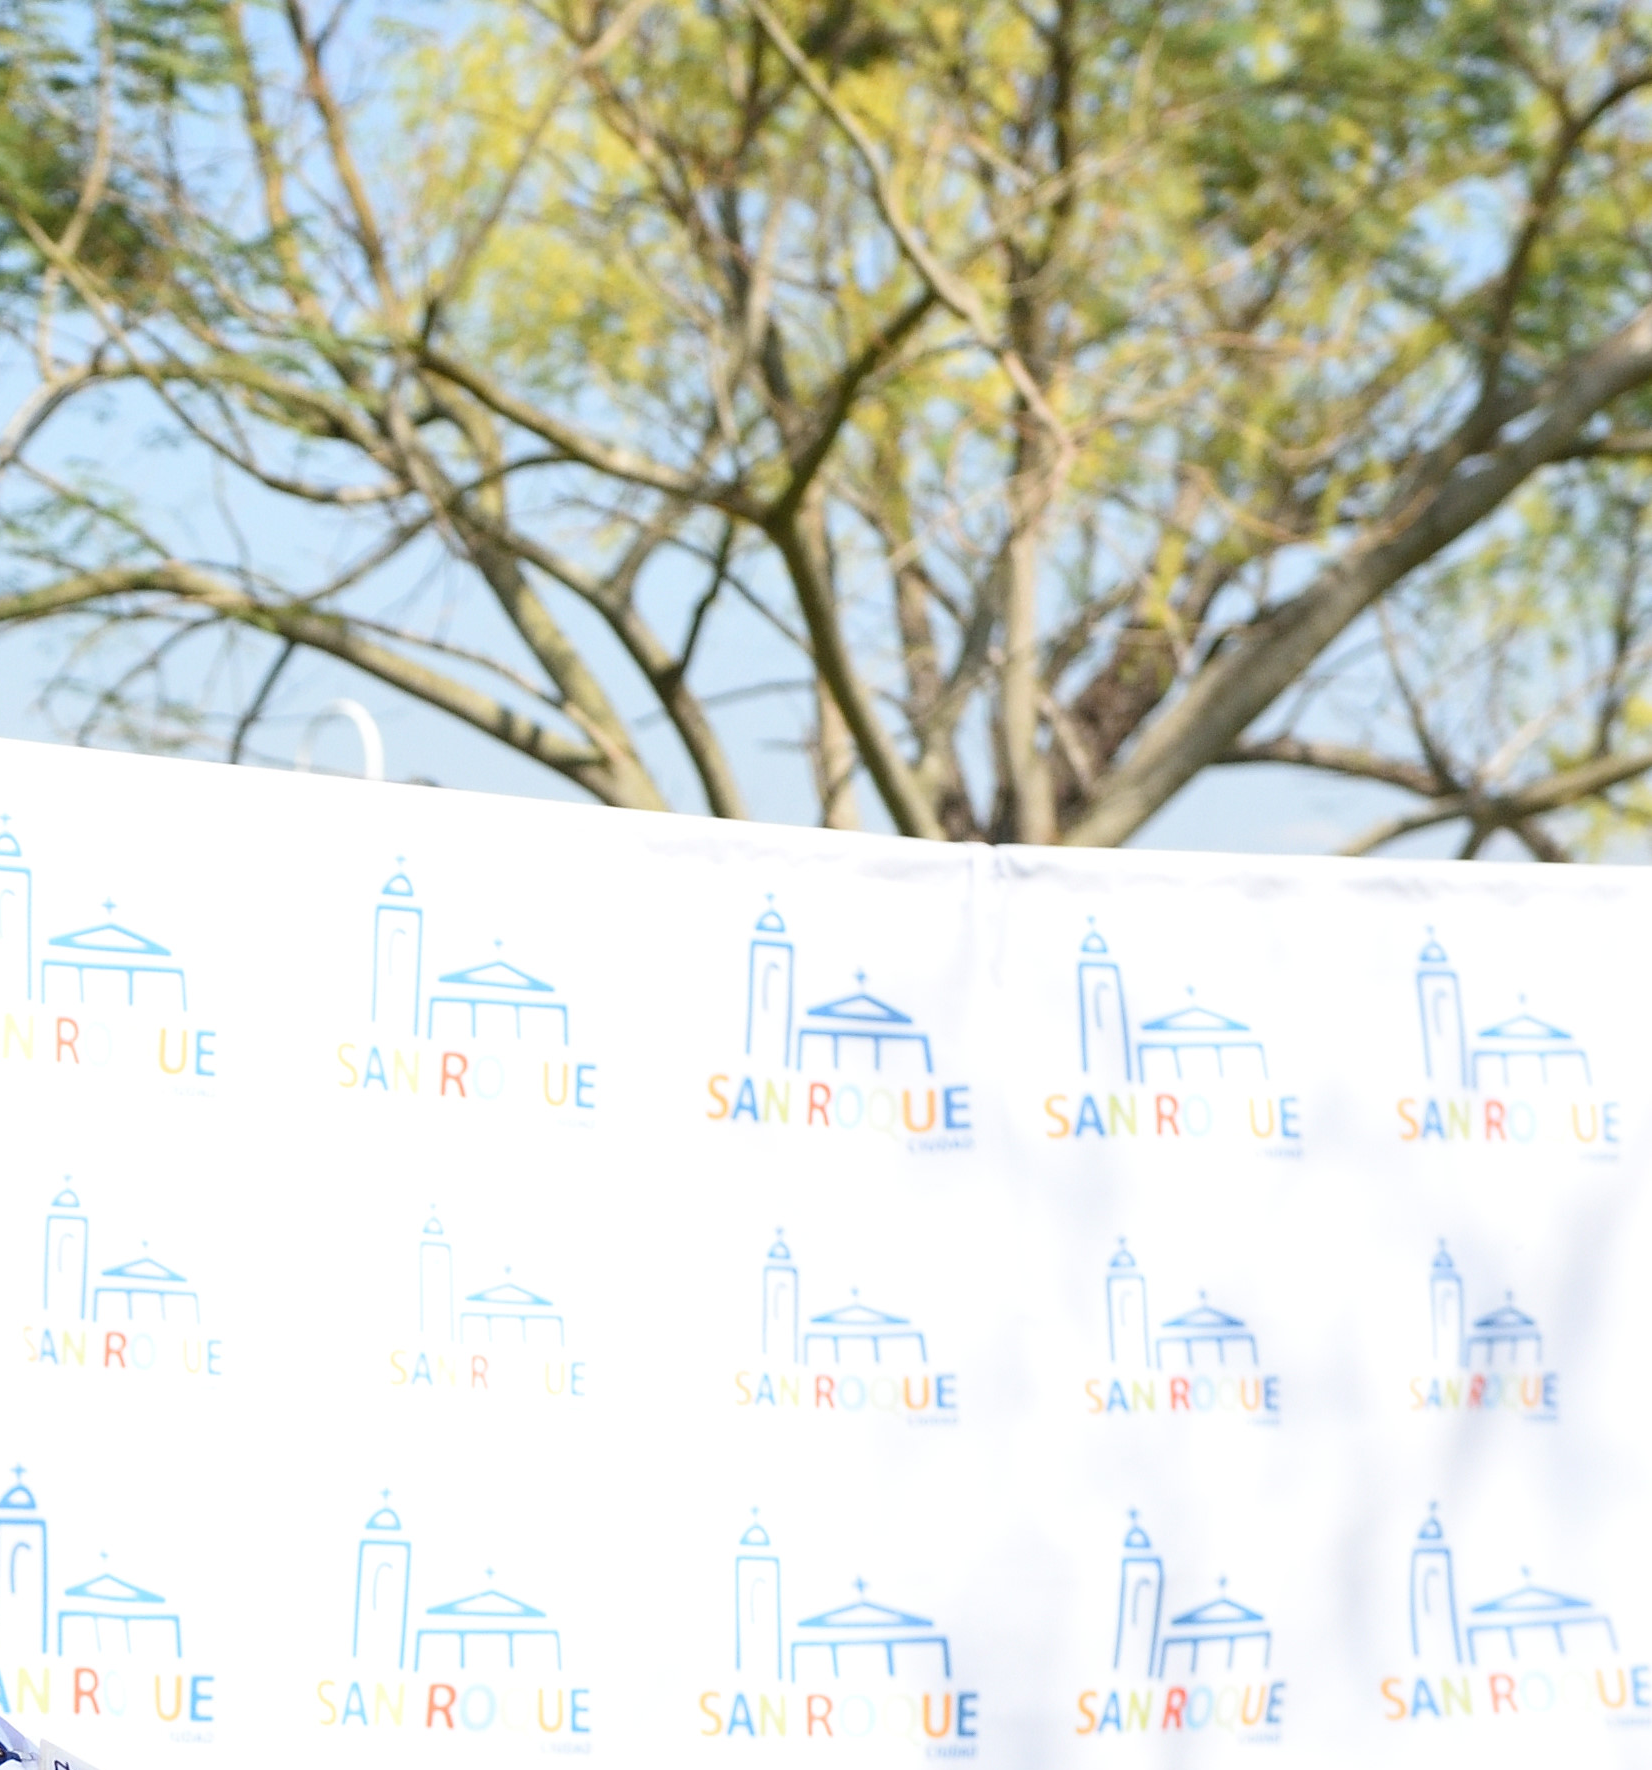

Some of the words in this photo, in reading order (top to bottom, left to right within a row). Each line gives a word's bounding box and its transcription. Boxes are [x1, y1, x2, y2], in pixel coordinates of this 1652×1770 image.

[55, 1016, 216, 1077] ROUE
[337, 1042, 420, 1094] SAN
[439, 1050, 598, 1110] ROUE
[705, 1072, 791, 1124] SAN
[806, 1081, 973, 1142] ROQUE
[1043, 1090, 1138, 1141] SAN
[1153, 1092, 1303, 1141] ROUE
[1395, 1096, 1473, 1143] SAN
[1483, 1097, 1621, 1144] ROUE
[23, 1325, 87, 1367] SAN
[103, 1330, 222, 1376] ROUE
[390, 1349, 457, 1387] SAN
[471, 1354, 585, 1397] RUE
[734, 1370, 799, 1407] SAN
[814, 1373, 959, 1417] ROQUE
[1084, 1377, 1156, 1416] SAN
[1408, 1376, 1464, 1412] SAN
[73, 1666, 216, 1724] ROUE
[316, 1680, 405, 1727] SAN
[698, 1690, 787, 1738] SAN
[805, 1688, 981, 1746] ROQUE
[1074, 1687, 1153, 1737] SAN
[1160, 1678, 1288, 1734] ROQUE
[1379, 1674, 1474, 1722] SAN
